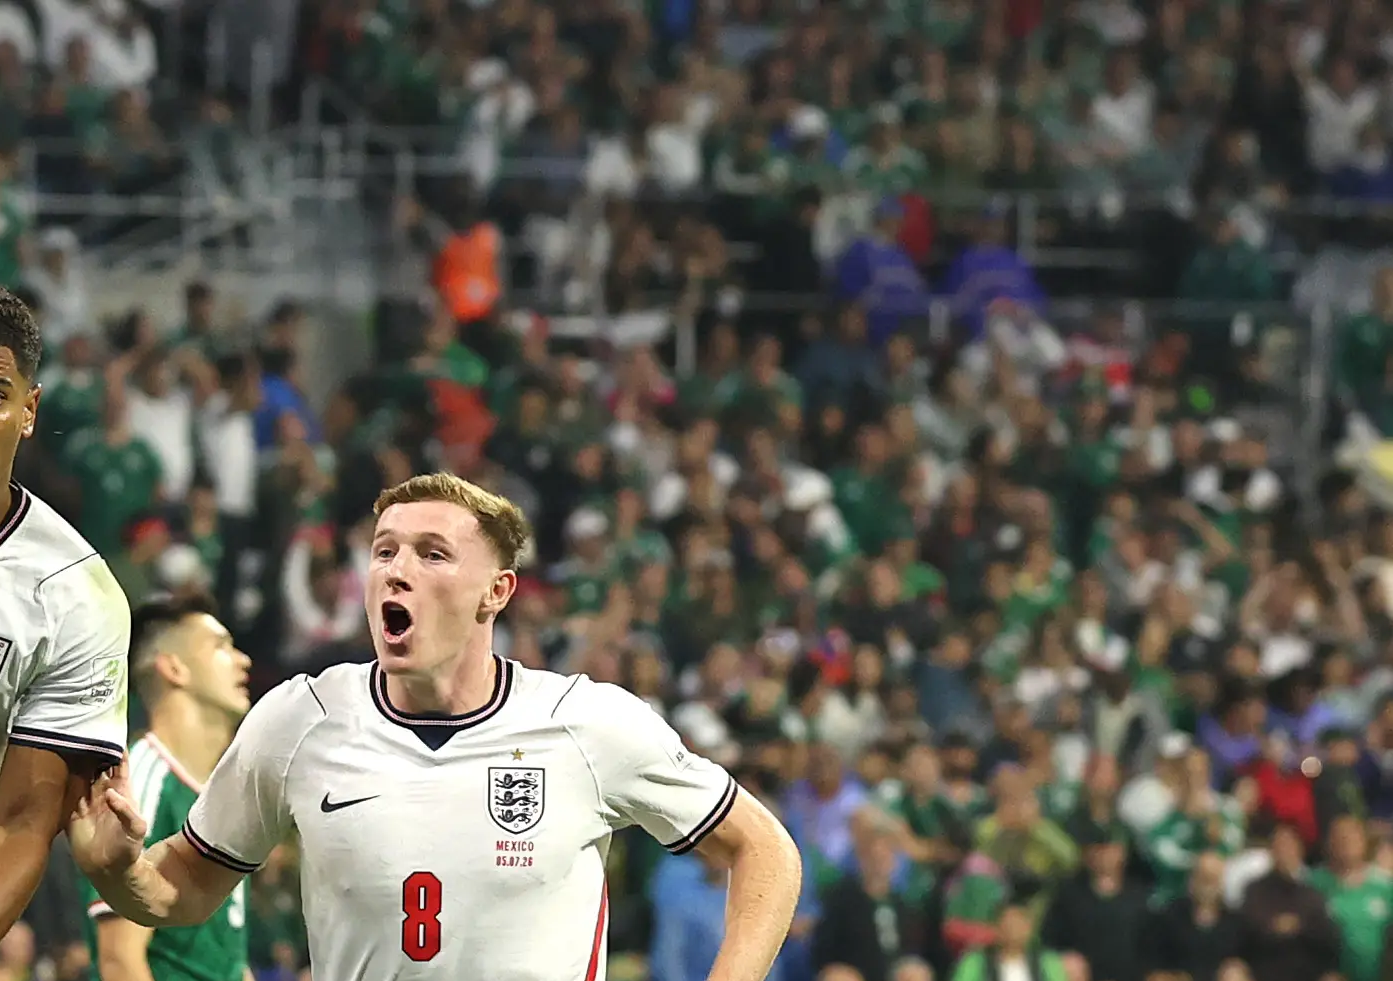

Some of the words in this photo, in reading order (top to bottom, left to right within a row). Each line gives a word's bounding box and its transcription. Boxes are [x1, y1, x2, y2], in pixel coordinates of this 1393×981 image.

[495, 840, 535, 852] MEXICO
[495, 855, 534, 867] 05.07.26
[401, 871, 442, 962] 8
